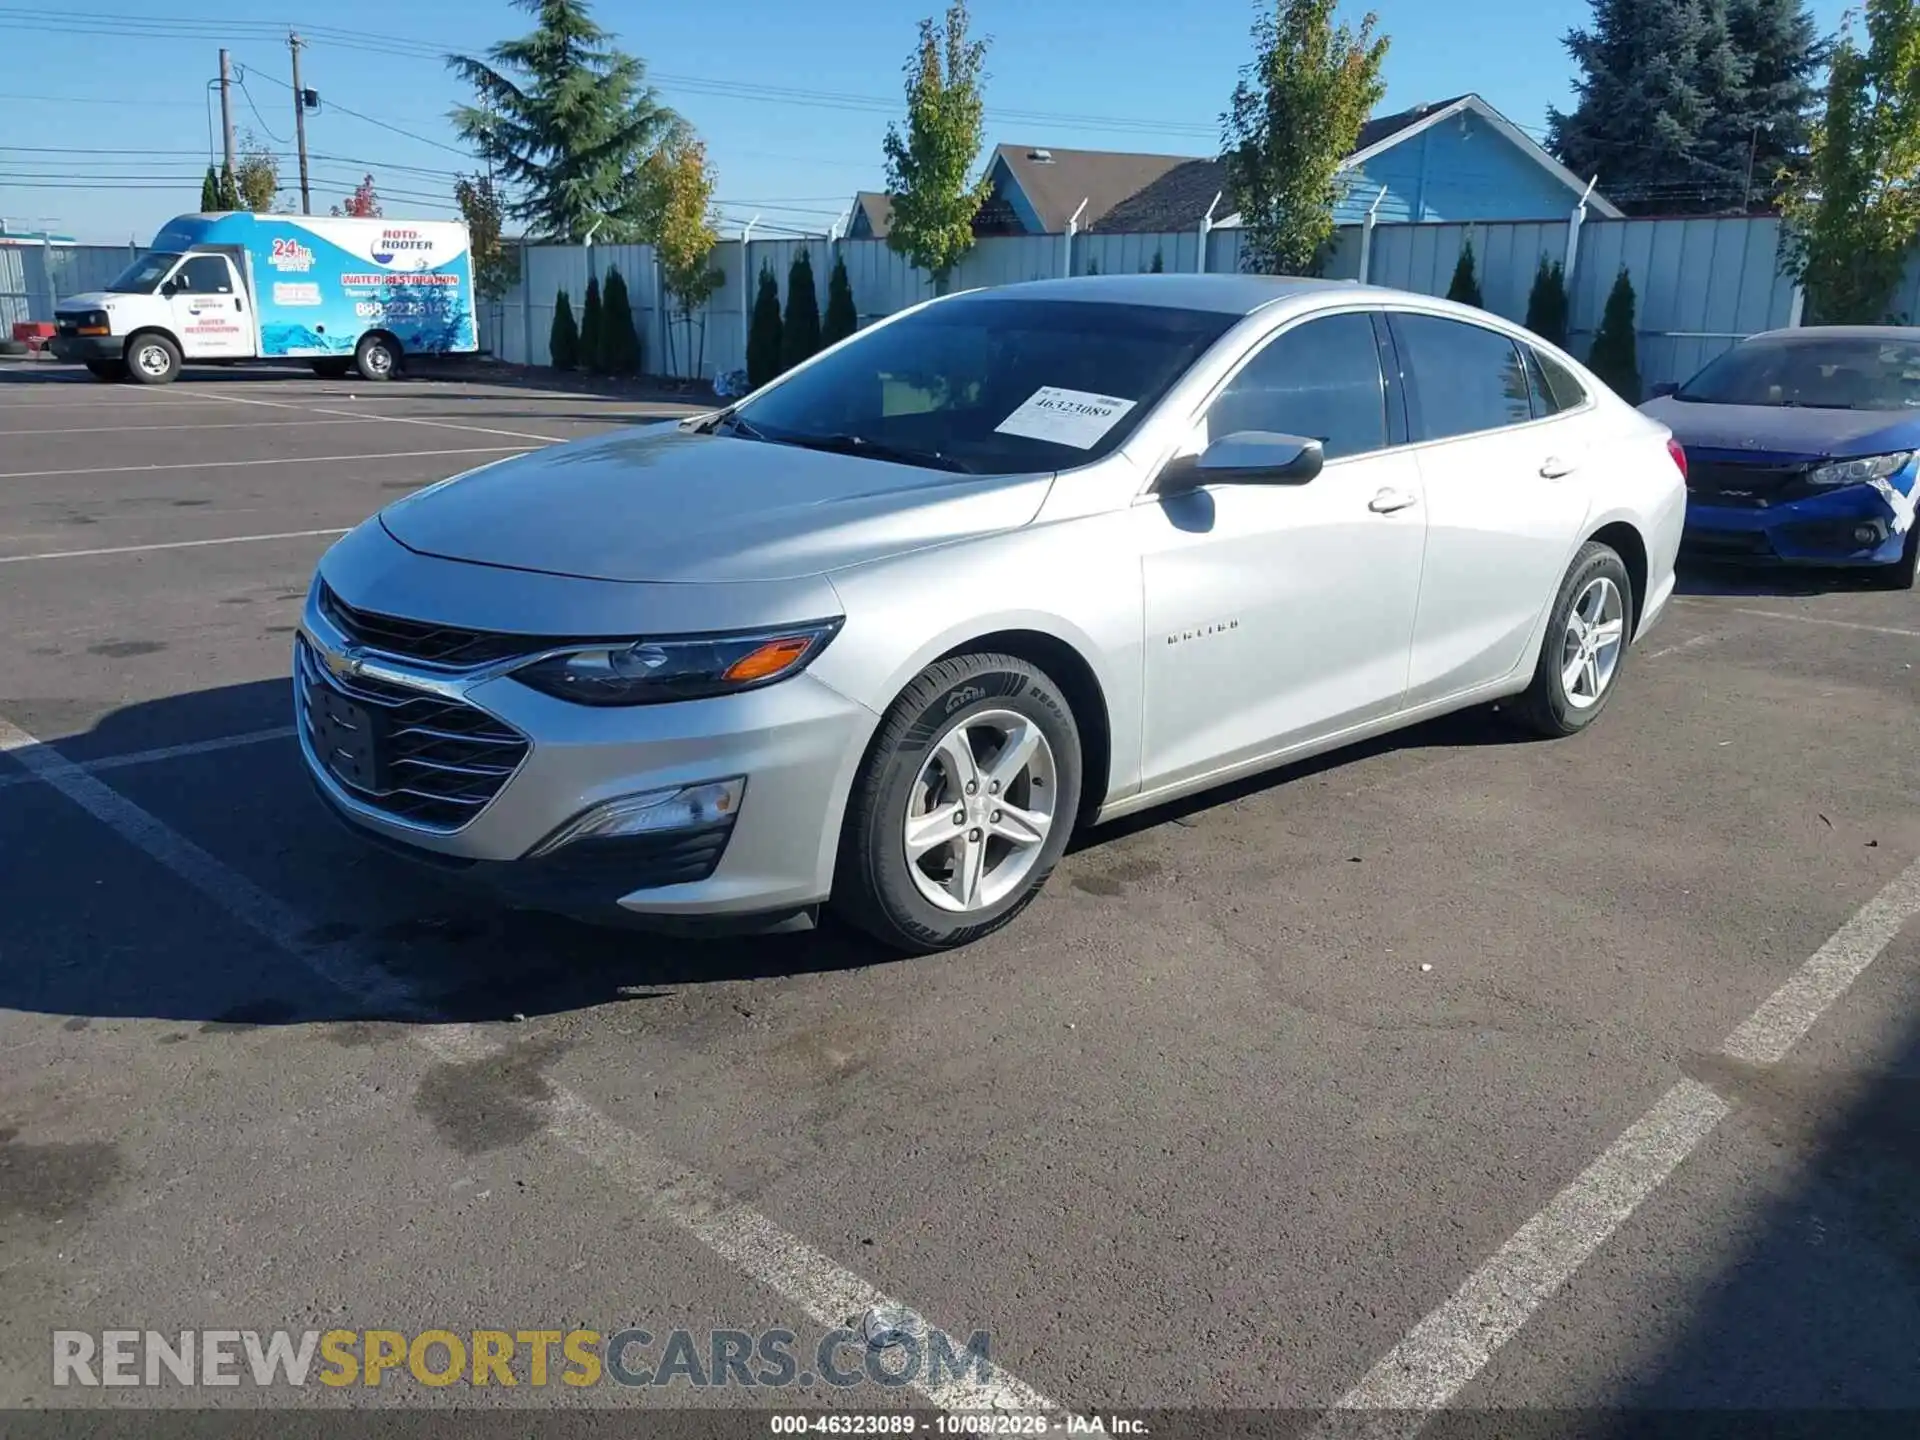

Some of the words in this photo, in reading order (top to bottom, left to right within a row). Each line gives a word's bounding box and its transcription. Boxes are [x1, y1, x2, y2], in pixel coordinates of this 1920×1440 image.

[381, 240, 433, 250] ROOTER
[342, 275, 381, 285] WATER
[385, 275, 458, 285] RESTORATION
[1036, 398, 1112, 418] 46323089
